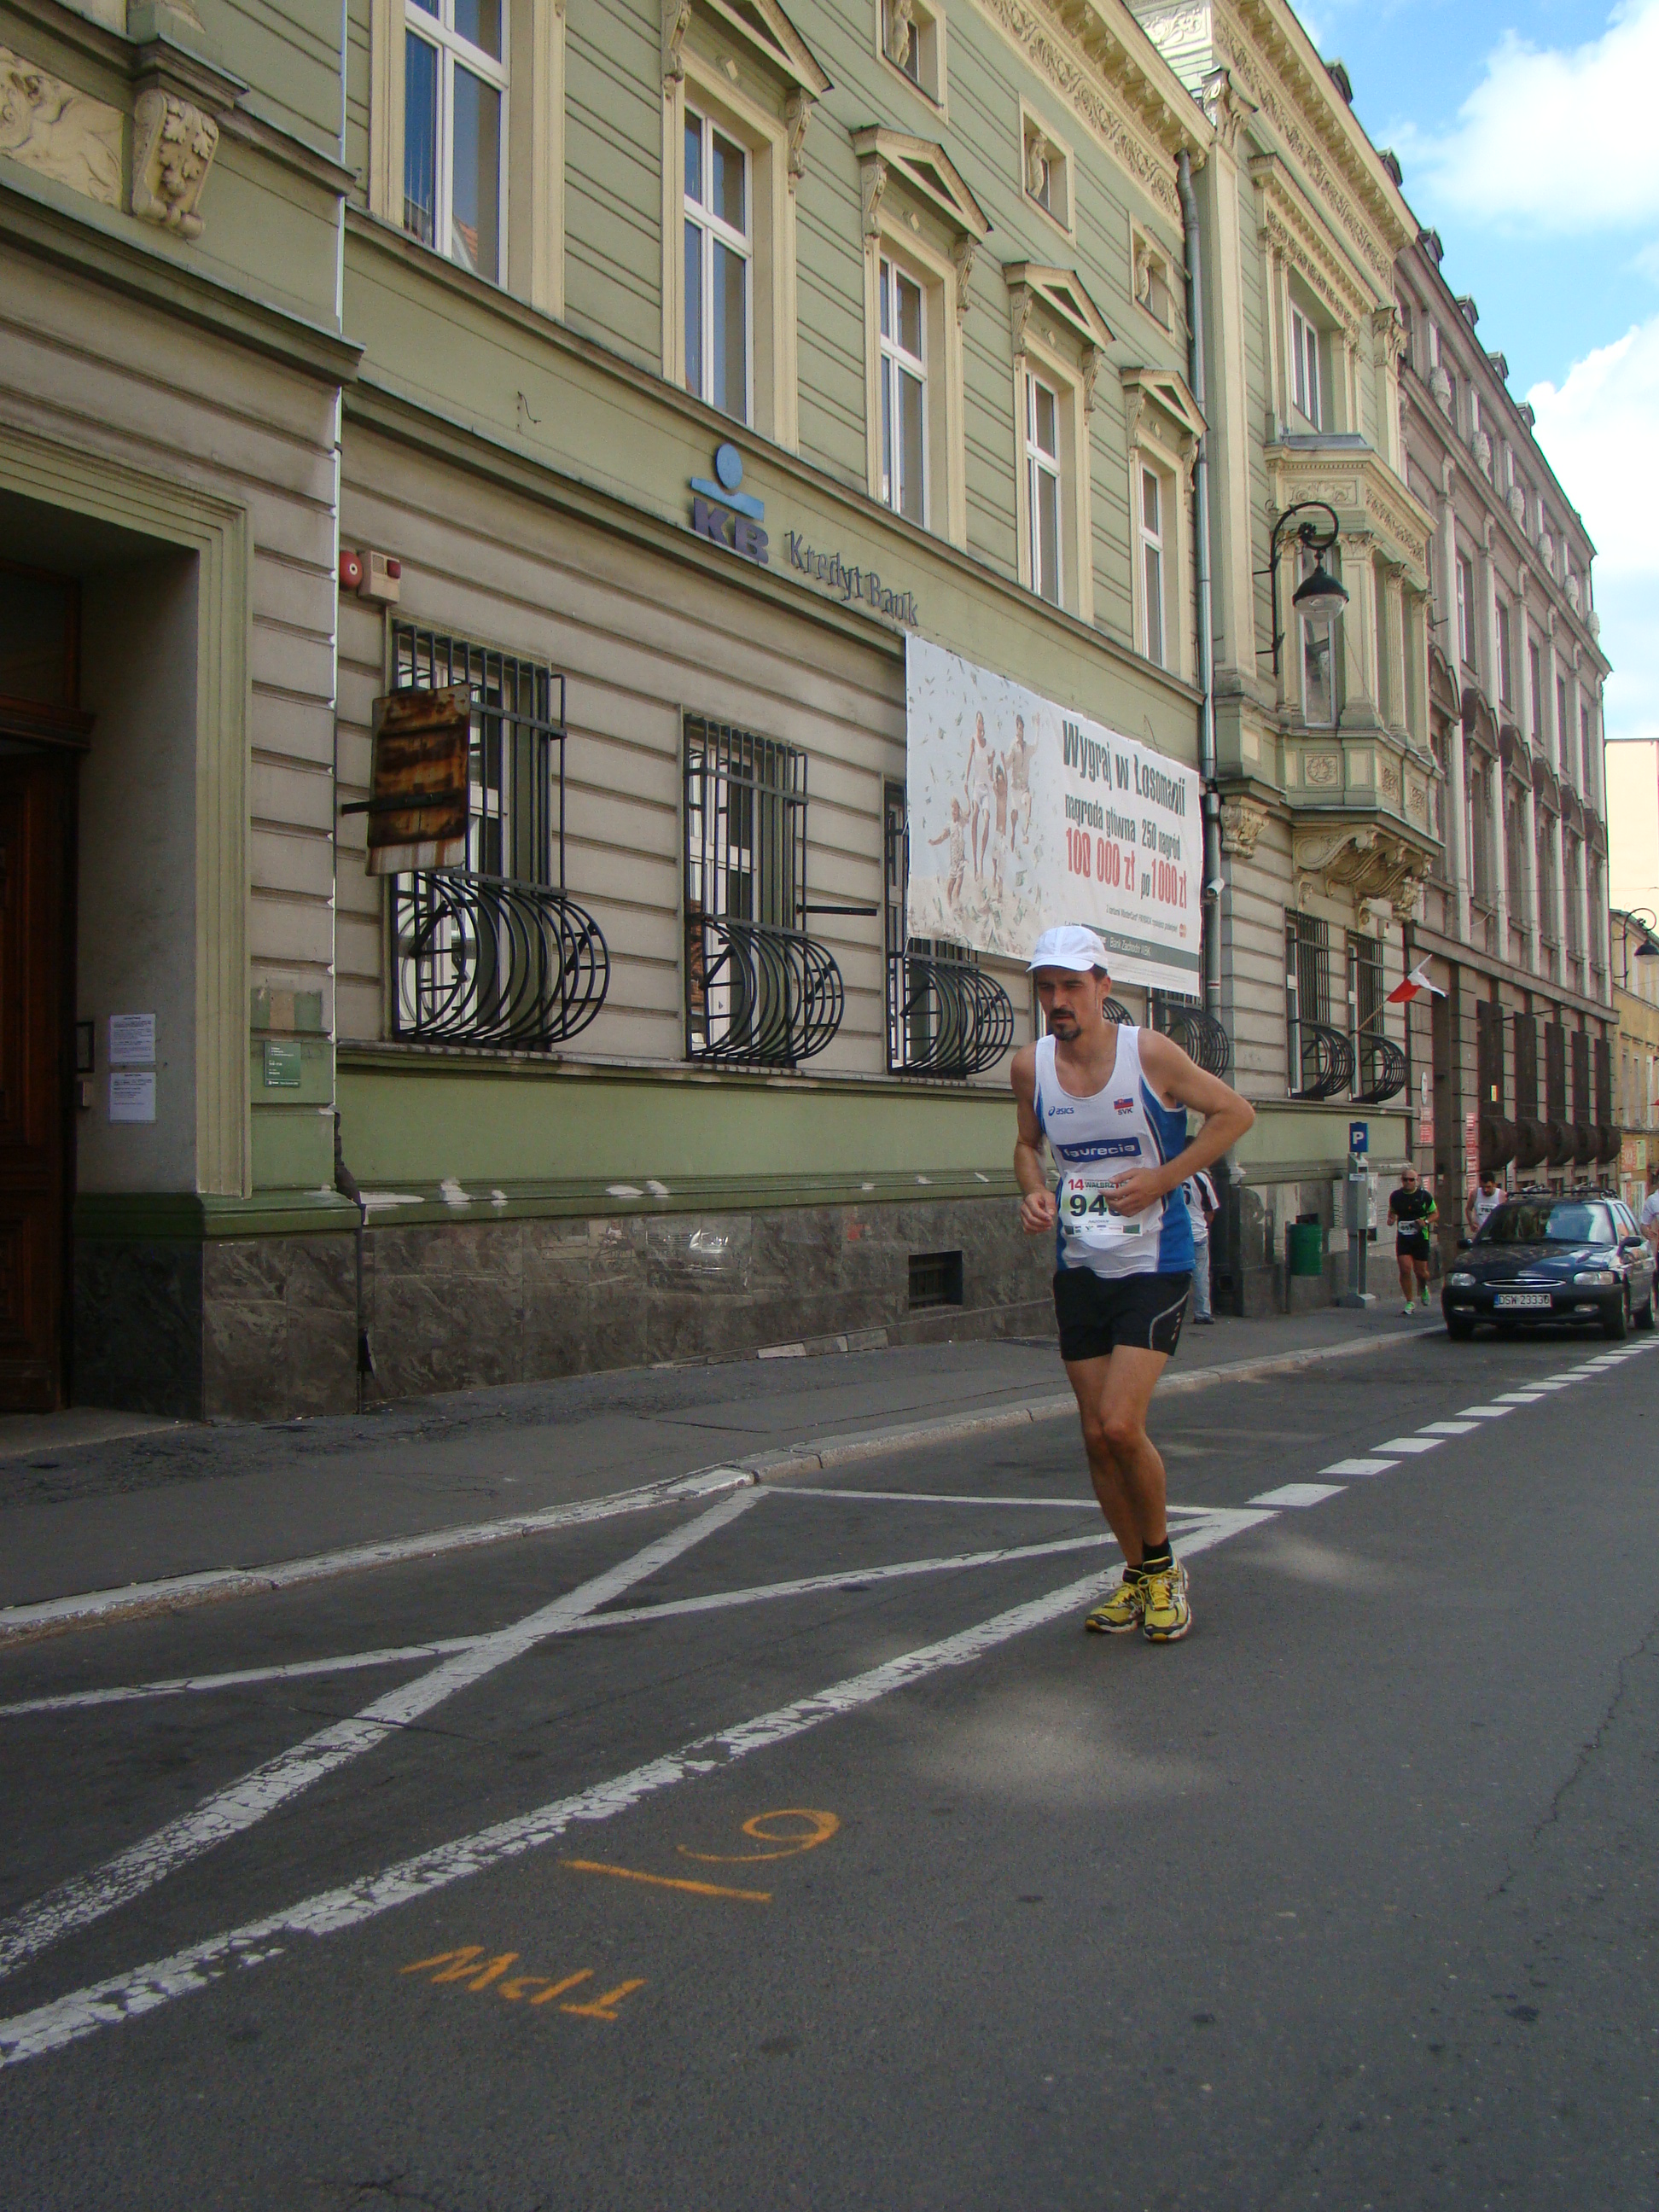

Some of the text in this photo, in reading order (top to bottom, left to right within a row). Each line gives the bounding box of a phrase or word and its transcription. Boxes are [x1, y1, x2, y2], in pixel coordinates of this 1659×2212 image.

[693, 496, 769, 565] KB
[789, 530, 919, 627] Kredyt Bank
[1062, 719, 1112, 791] Wygraj
[1115, 754, 1129, 791] w
[1065, 794, 1103, 830] nagroda
[1142, 818, 1156, 851] 250
[1066, 827, 1135, 891] 100 000 zł
[1140, 872, 1150, 899] po
[1056, 1107, 1074, 1115] asics
[1352, 1132, 1365, 1144] P
[1068, 1179, 1084, 1190] 14
[1070, 1194, 1125, 1217] 94
[1499, 1295, 1516, 1305] DSW
